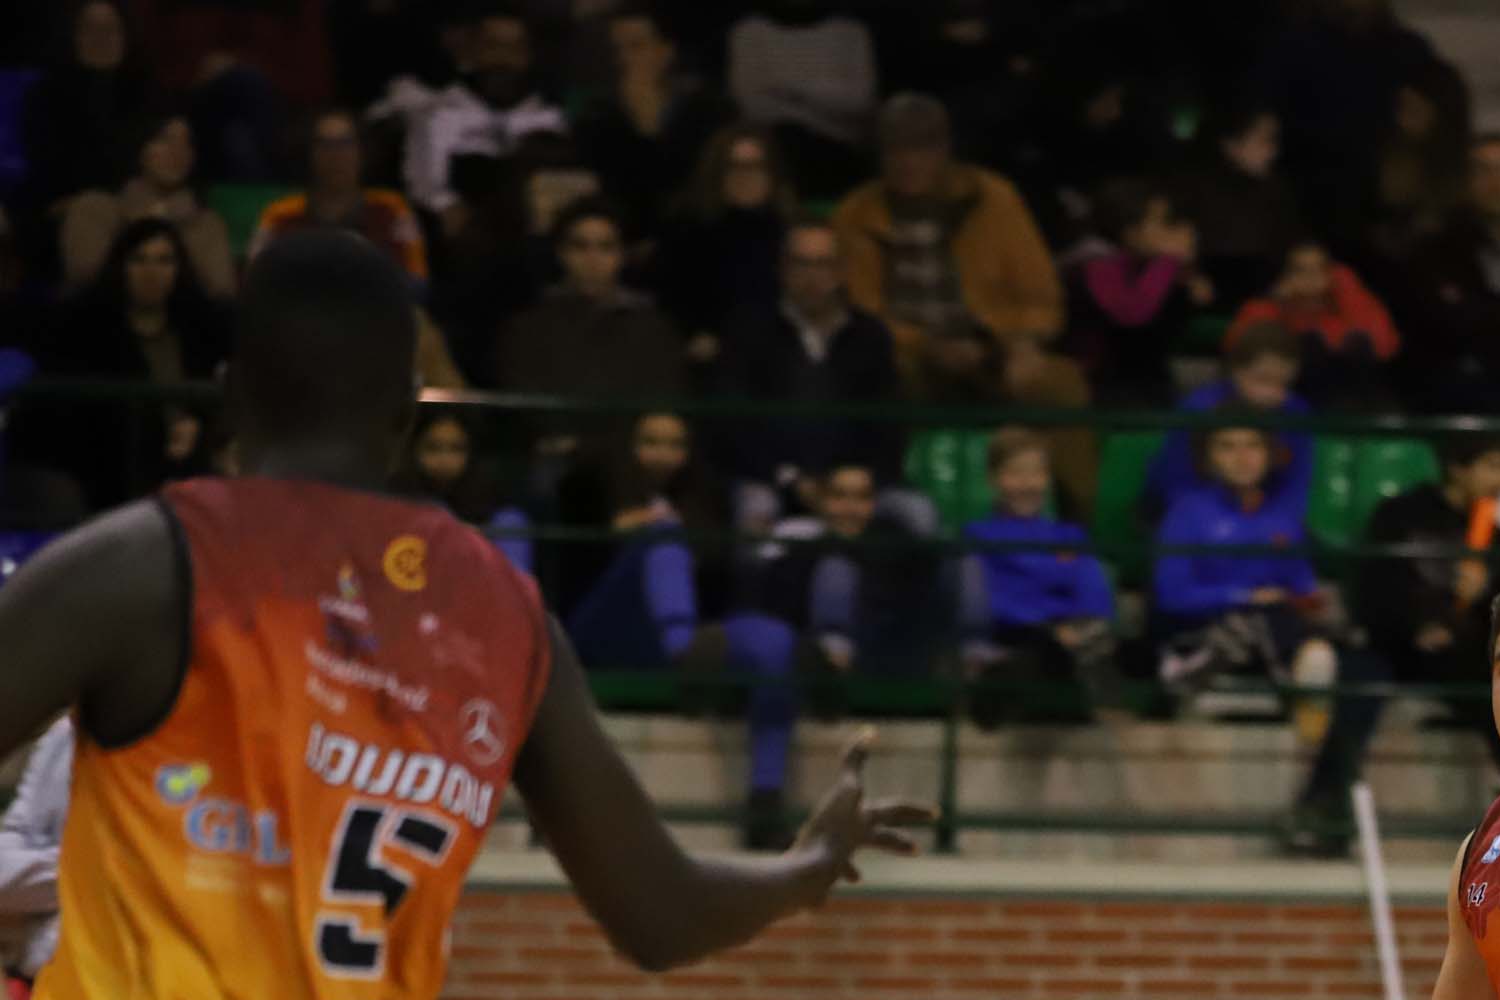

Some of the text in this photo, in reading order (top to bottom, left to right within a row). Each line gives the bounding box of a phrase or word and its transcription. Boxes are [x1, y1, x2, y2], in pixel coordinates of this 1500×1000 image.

[184, 798, 293, 866] GIL
[313, 798, 461, 983] 5
[1467, 880, 1489, 907] 14
